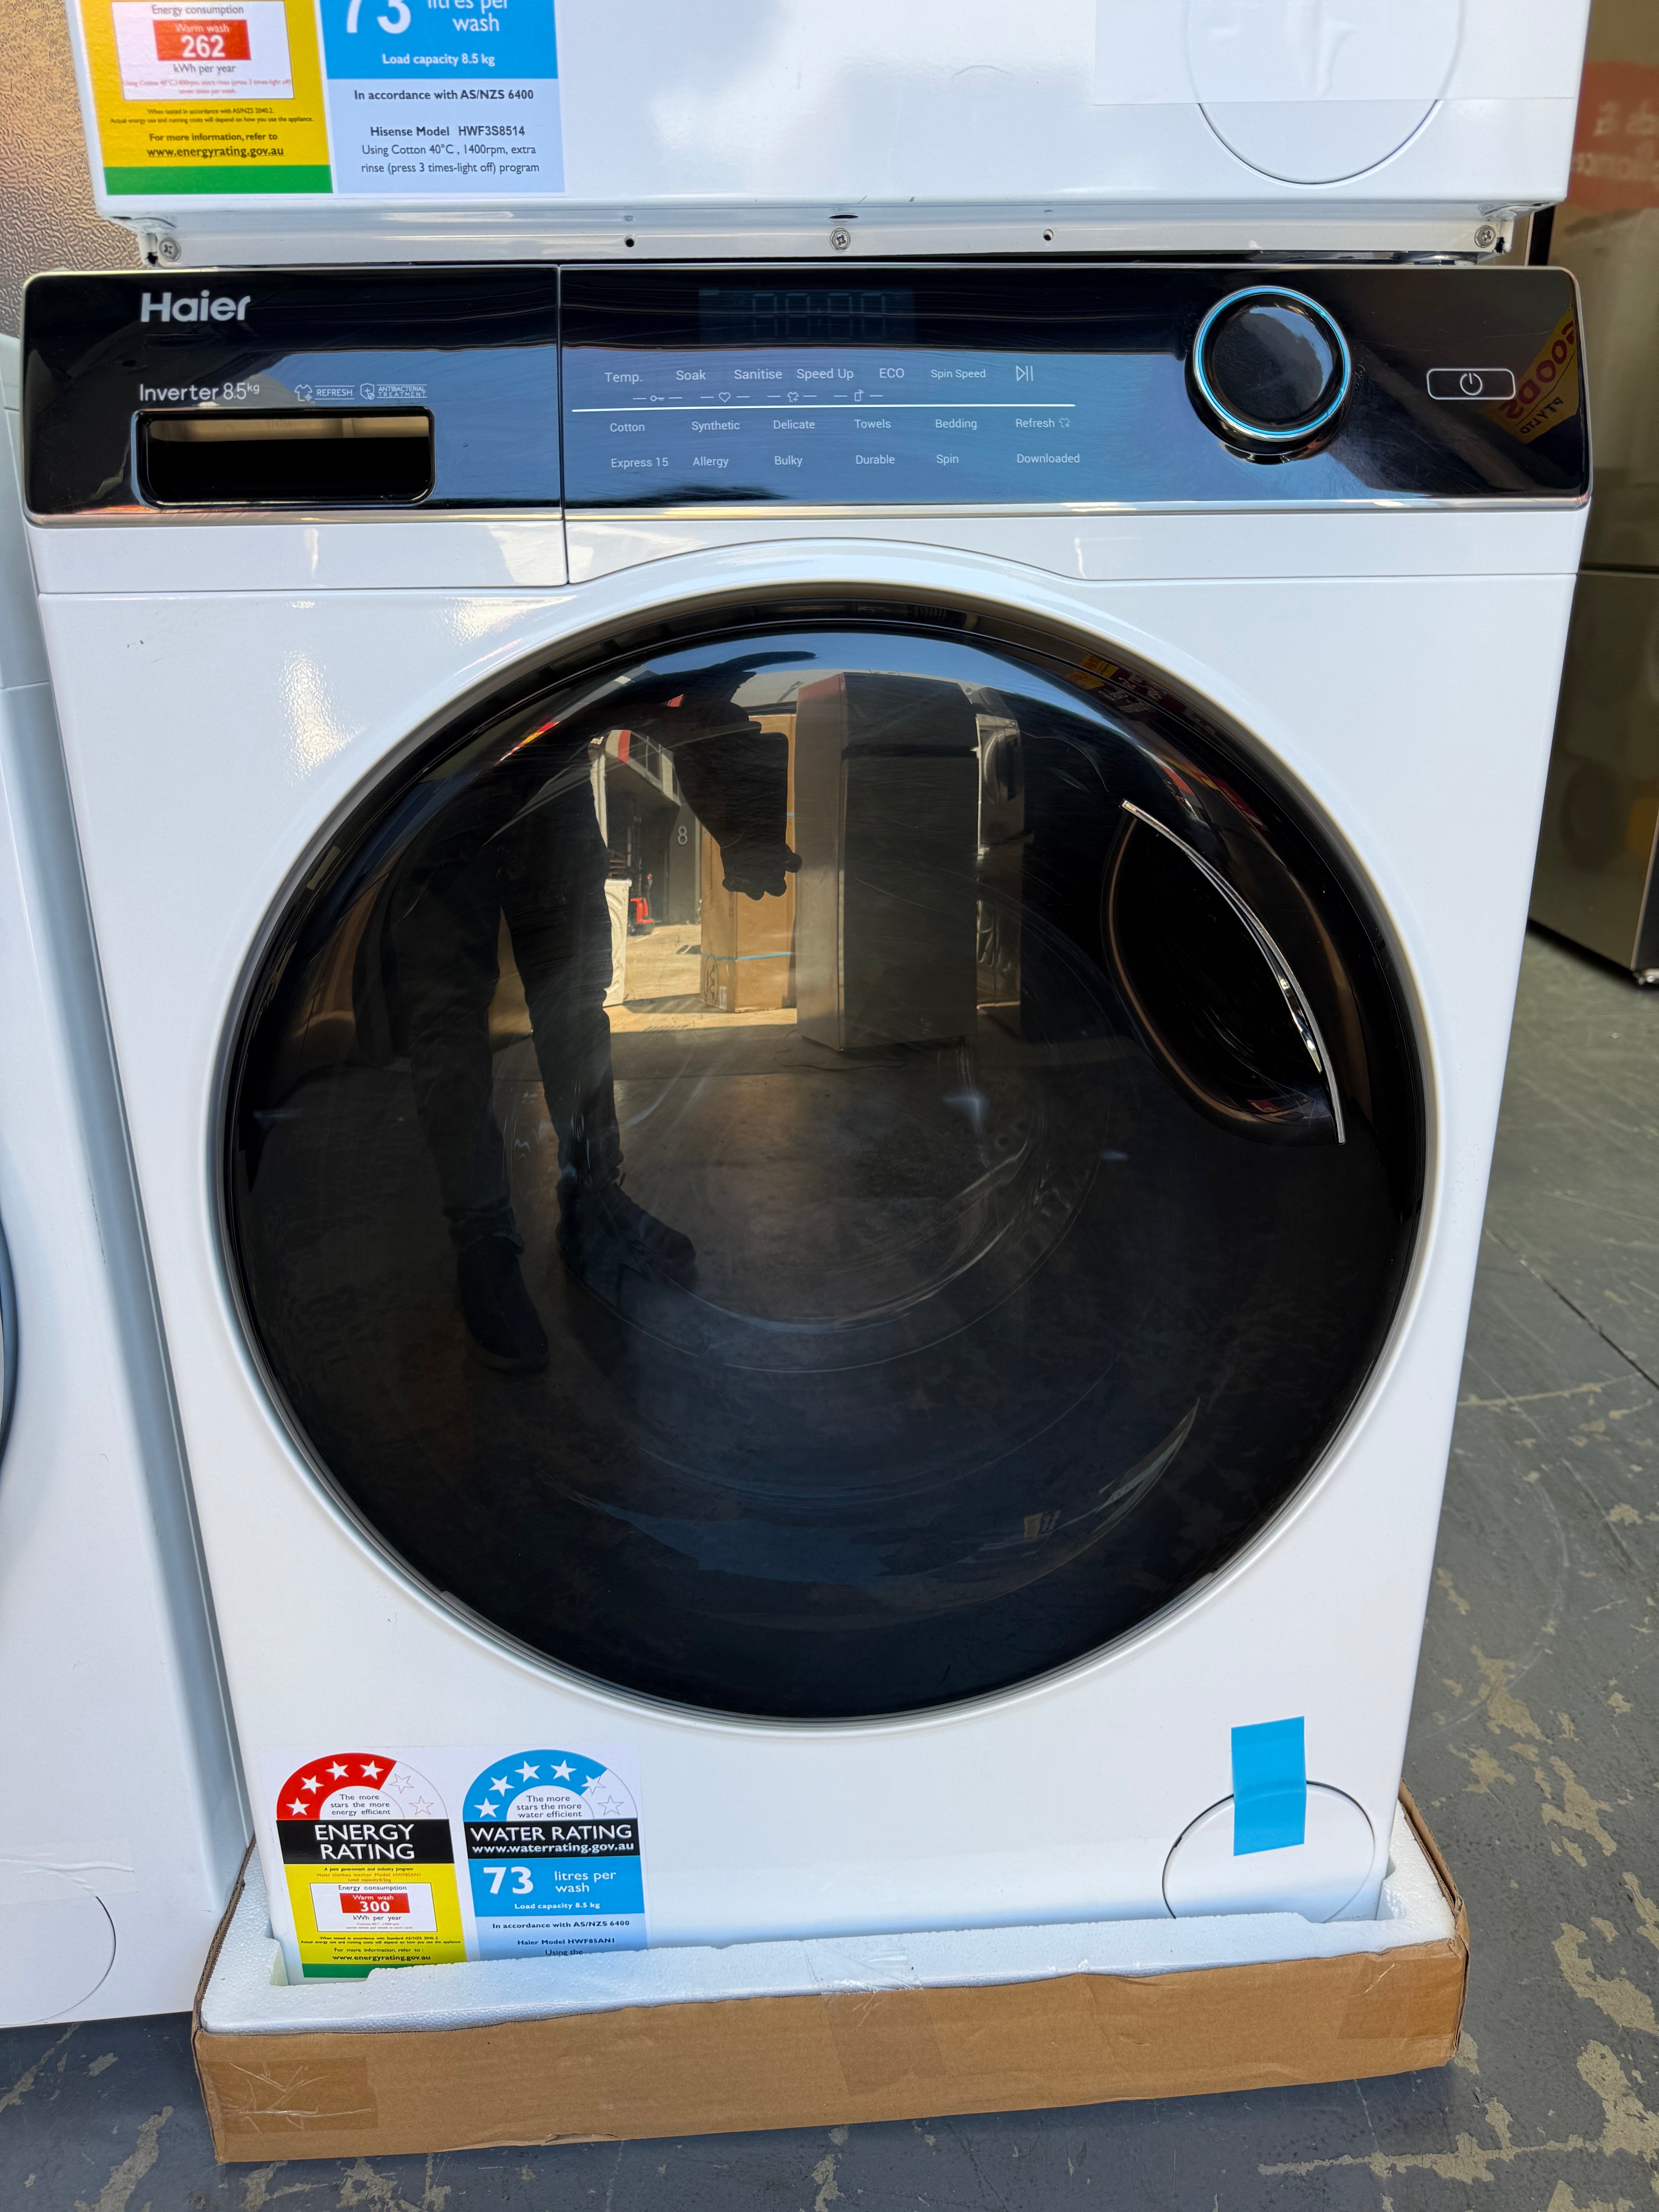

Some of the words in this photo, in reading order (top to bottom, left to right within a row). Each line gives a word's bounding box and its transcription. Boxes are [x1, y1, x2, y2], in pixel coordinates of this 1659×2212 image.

[152, 5, 182, 16] Energy
[185, 5, 244, 16] consumption
[453, 12, 500, 32] wash
[175, 23, 204, 33] Warm
[206, 23, 230, 33] wash
[181, 35, 226, 58] 262
[382, 54, 410, 64] Load
[413, 54, 459, 67] capacity
[461, 54, 479, 64] 8.5
[481, 53, 495, 67] kg
[173, 64, 196, 73] kWh
[199, 65, 214, 75] per
[216, 65, 236, 75] year
[354, 90, 365, 100] In
[368, 89, 431, 100] accordance
[434, 89, 458, 100] with
[460, 89, 504, 100] AS/NZS
[508, 89, 534, 100] 6400
[370, 126, 413, 136] Hisense
[416, 126, 450, 136] Model
[458, 125, 525, 136] HWF3S8514
[192, 133, 244, 141] information,
[146, 146, 284, 158] www.energyrating.gov.au
[362, 145, 388, 157] Using
[392, 144, 426, 155] Cotton
[429, 144, 454, 154] 40°C
[464, 144, 508, 157] 1400rpm,
[511, 146, 536, 155] extra
[361, 163, 385, 173] rinse
[388, 162, 416, 175] (press
[419, 163, 425, 172] 3
[428, 163, 477, 175] times-light
[480, 162, 496, 174] off)
[499, 164, 540, 175] program
[141, 290, 251, 323] Haier
[605, 371, 643, 385] Temp.
[676, 369, 706, 381] Soak
[734, 369, 783, 380] Sanitise
[797, 369, 833, 381] Speed
[838, 368, 854, 380] Up
[879, 368, 905, 378] ECO
[931, 369, 953, 380] Spin
[955, 369, 986, 380] Speed
[139, 383, 219, 402] Inverter
[316, 388, 353, 397] REFRESH
[610, 422, 645, 433] Cotton
[691, 420, 740, 433] Synthetic
[773, 419, 815, 430] Delicate
[854, 419, 891, 429] Towels
[936, 419, 977, 430] Bedding
[1016, 418, 1055, 428] Refresh
[611, 458, 653, 470] Express
[656, 457, 668, 467] 15
[693, 456, 729, 468] Allergy
[774, 455, 803, 467] Bulky
[856, 455, 895, 465] Durable
[936, 454, 959, 465] Spin
[1017, 453, 1080, 464] Downloaded
[314, 1824, 414, 1841] ENERGY
[470, 1826, 546, 1842] WATER
[551, 1824, 632, 1841] RATING
[320, 1844, 415, 1860] RATING
[472, 1842, 634, 1854] www.waterrating.gov.au
[483, 1866, 534, 1895] 73
[554, 1871, 589, 1881] litres
[594, 1872, 617, 1883] per
[555, 1882, 590, 1893] wash
[359, 1901, 390, 1912] 300
[538, 1902, 573, 1911] capacity
[589, 1901, 600, 1910] kg
